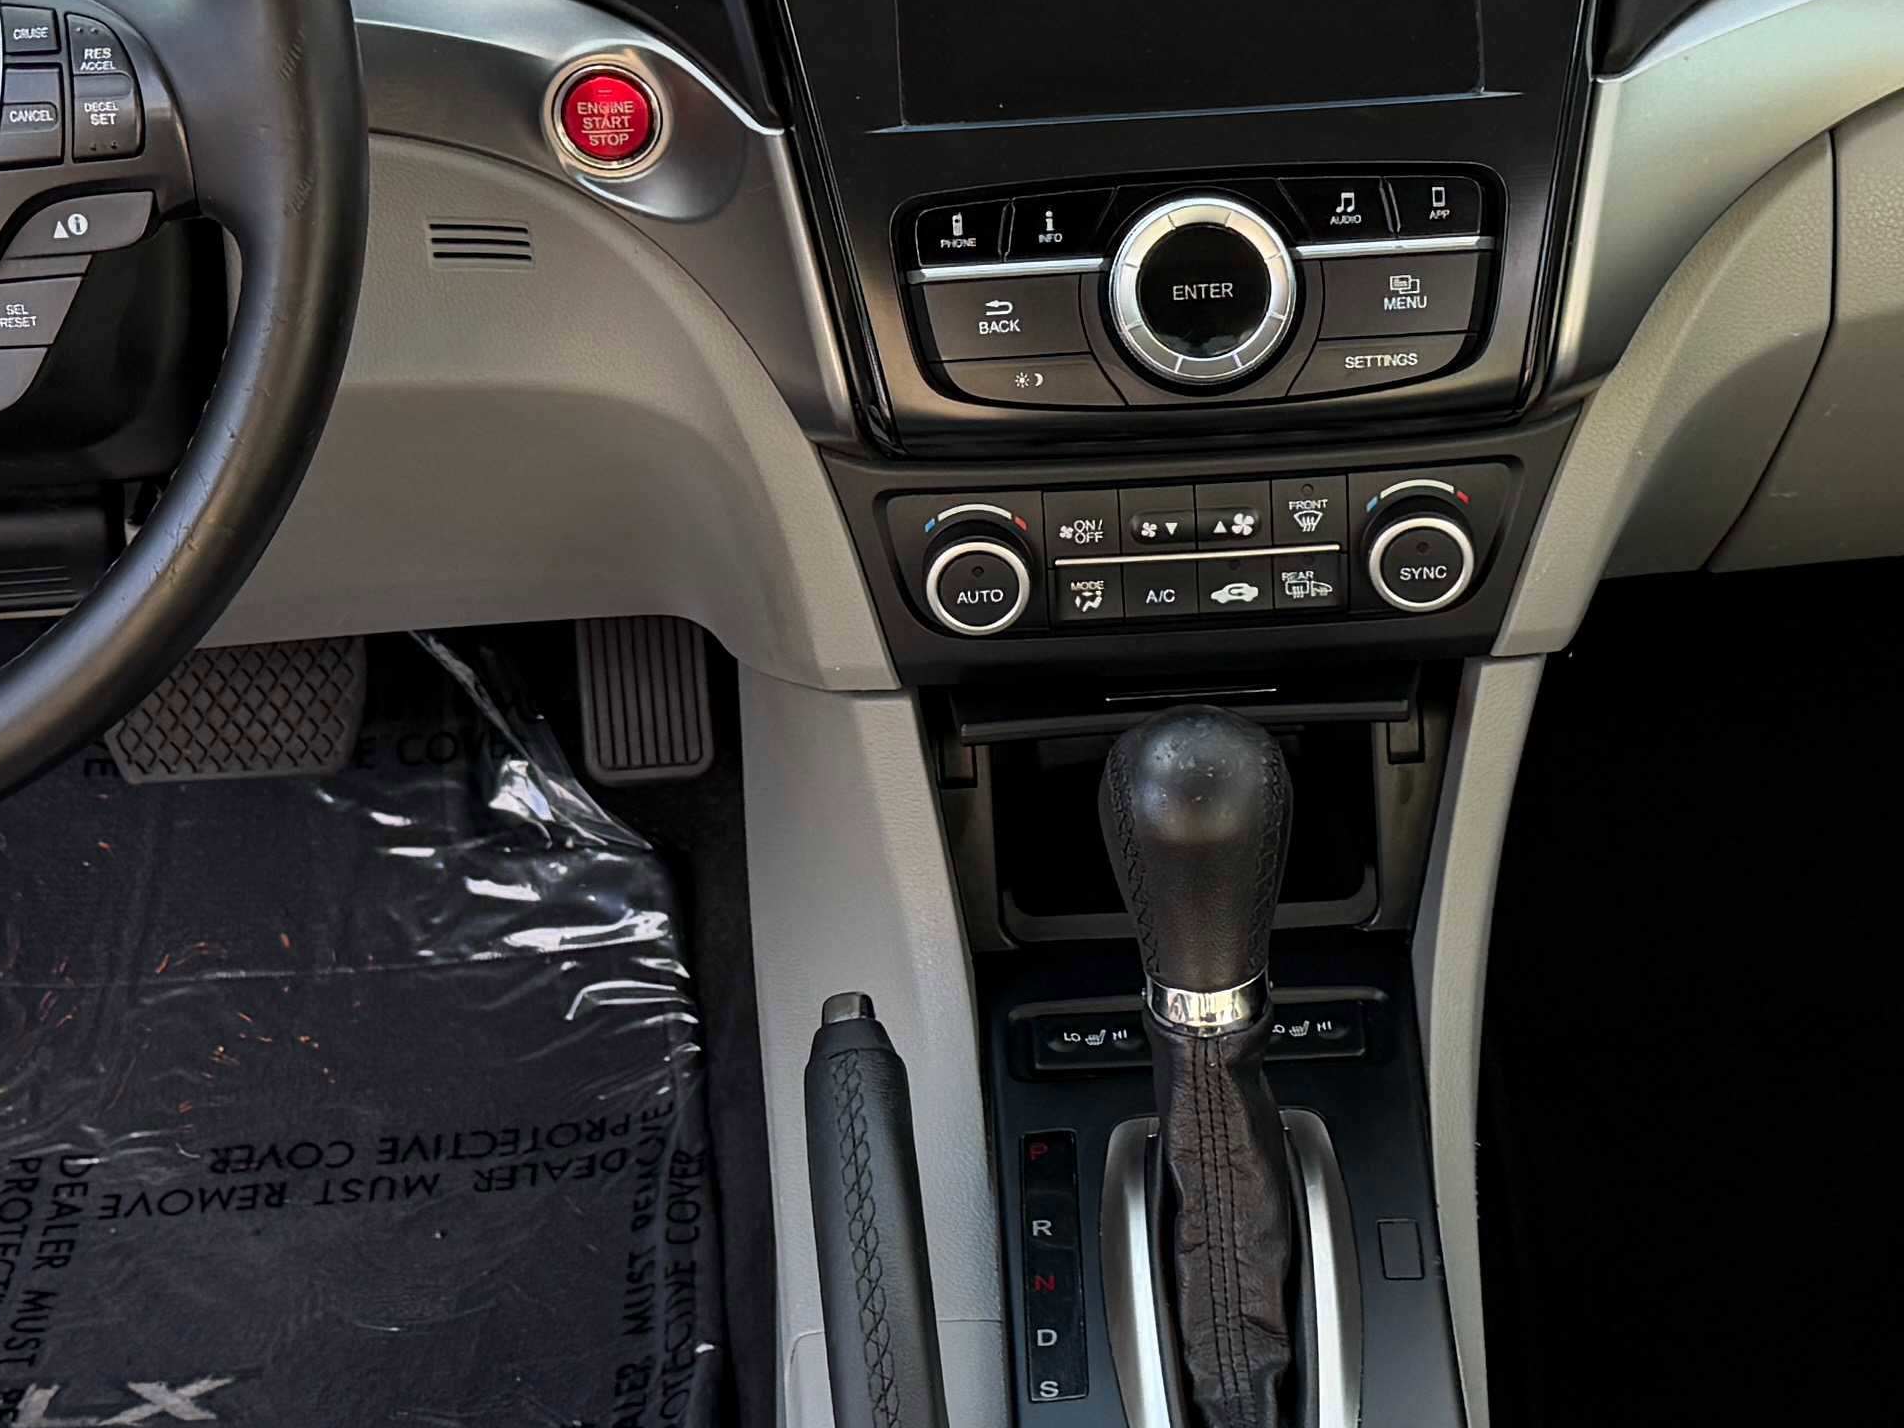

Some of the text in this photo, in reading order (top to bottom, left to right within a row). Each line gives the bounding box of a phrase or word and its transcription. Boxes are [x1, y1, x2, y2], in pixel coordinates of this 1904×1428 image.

[13, 27, 49, 40] CRUISE
[84, 47, 112, 60] RES
[80, 59, 117, 71] ACCEL
[84, 101, 120, 113] DECEL
[576, 100, 635, 115] ENGINE
[9, 109, 54, 123] CANCEL
[89, 112, 117, 126] SET
[582, 115, 632, 130] START
[588, 133, 630, 147] STOP
[1329, 214, 1362, 226] AUDIO
[1429, 209, 1450, 220] APP
[940, 237, 977, 249] PHONE
[1038, 232, 1063, 245] INFO
[1172, 281, 1234, 302] ENTER
[6, 304, 29, 316] SEL
[1383, 295, 1428, 311] MENU
[0, 315, 37, 328] RESET
[978, 319, 1021, 335] BACK
[1344, 352, 1418, 370] SETTINGS
[1288, 498, 1328, 511] FRONT
[1073, 531, 1104, 545] OFF
[1281, 570, 1314, 583] REAR
[1399, 565, 1448, 581] SYNC
[1070, 580, 1105, 591] MODE
[956, 588, 1004, 605] AUTO
[1145, 588, 1176, 605] A/C
[1316, 1021, 1333, 1032] HI
[1063, 1032, 1081, 1043] LO
[210, 1111, 631, 1174] PROTECTIVE COVER
[1029, 1142, 1048, 1161] P
[98, 1146, 628, 1221] DEALER MUST REMOVE
[31, 1153, 95, 1272] DEALER
[1031, 1219, 1053, 1237] R
[622, 1244, 657, 1337] MUST
[1034, 1275, 1057, 1293] N
[0, 1283, 58, 1369] MUST
[1036, 1328, 1058, 1347] D
[1039, 1380, 1060, 1398] S
